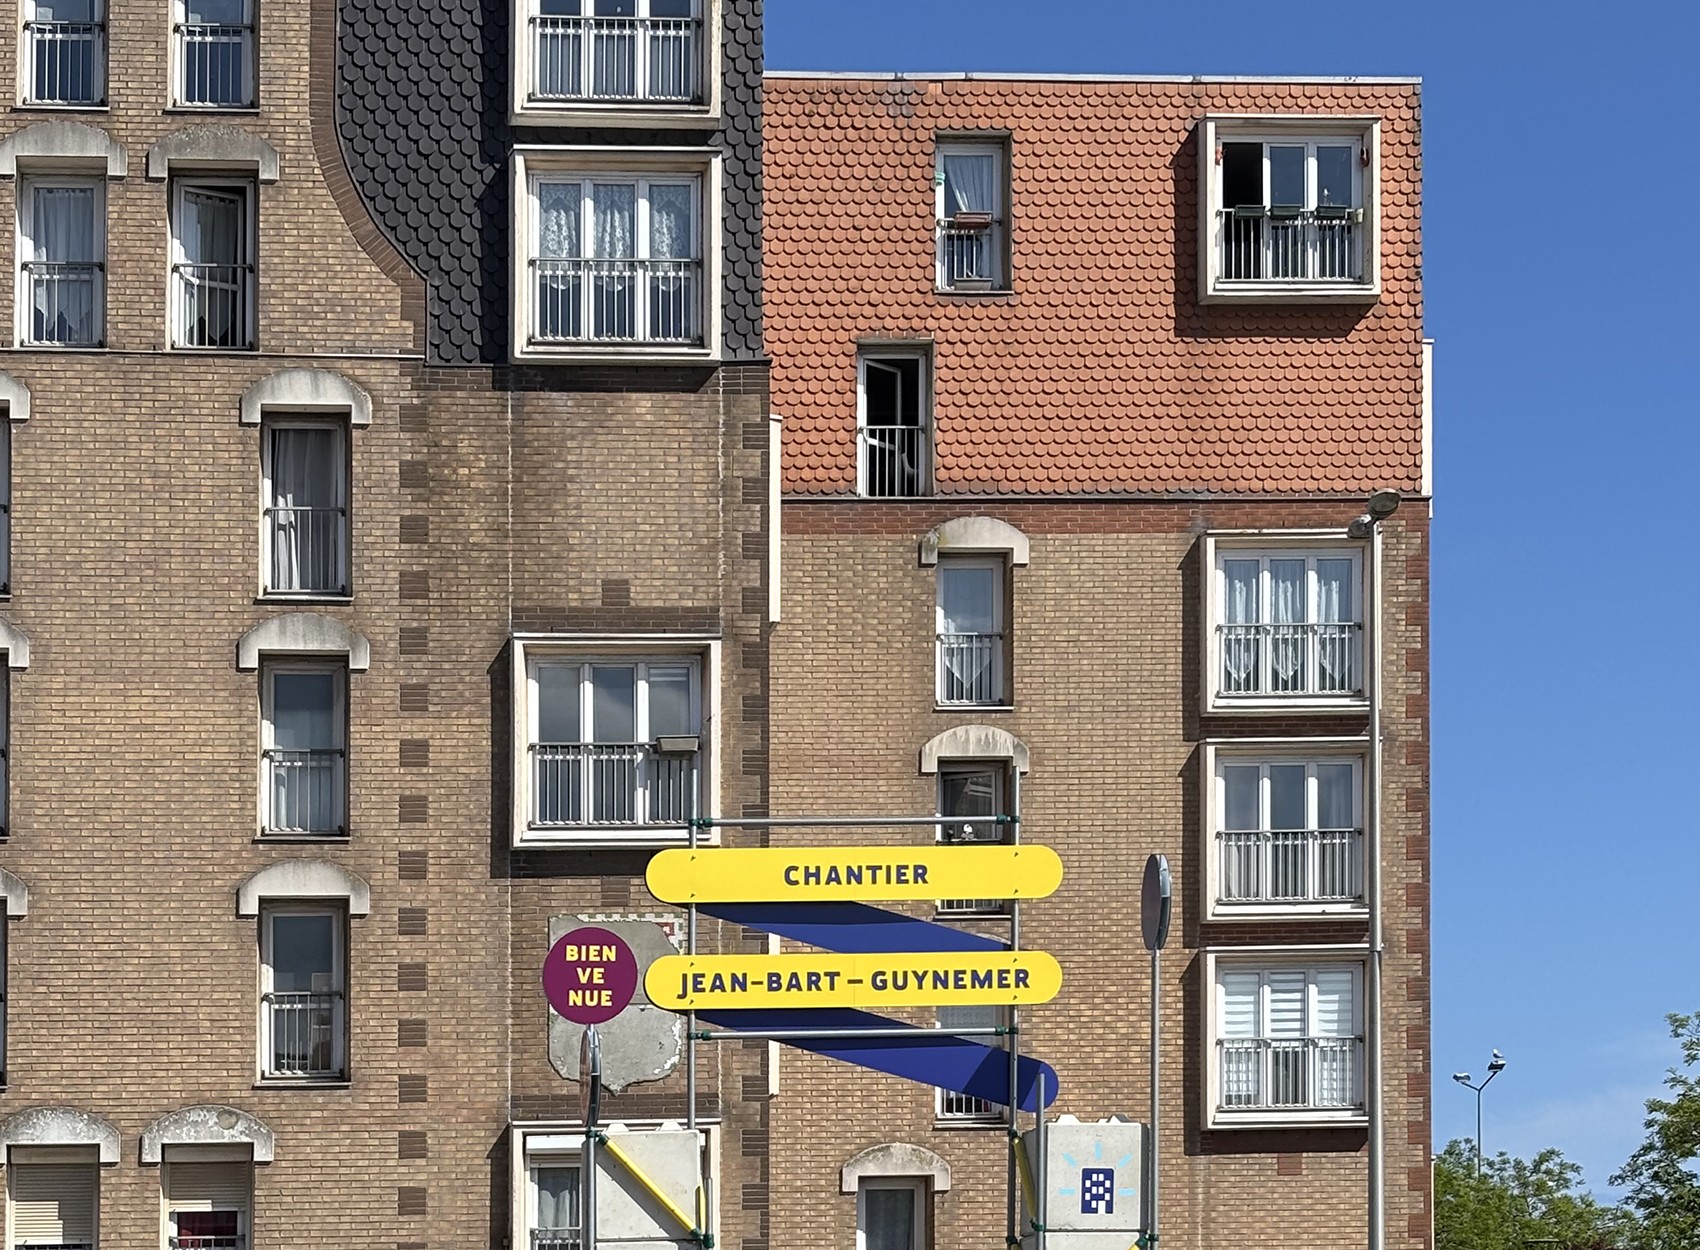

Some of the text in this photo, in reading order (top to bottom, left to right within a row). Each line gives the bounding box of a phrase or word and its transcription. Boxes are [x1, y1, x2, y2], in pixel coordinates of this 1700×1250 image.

[784, 864, 929, 886] CHANTIER
[565, 945, 616, 962] BIEN
[576, 967, 605, 984] VE
[871, 968, 1030, 991] GUYNEMER
[568, 989, 613, 1007] NUE
